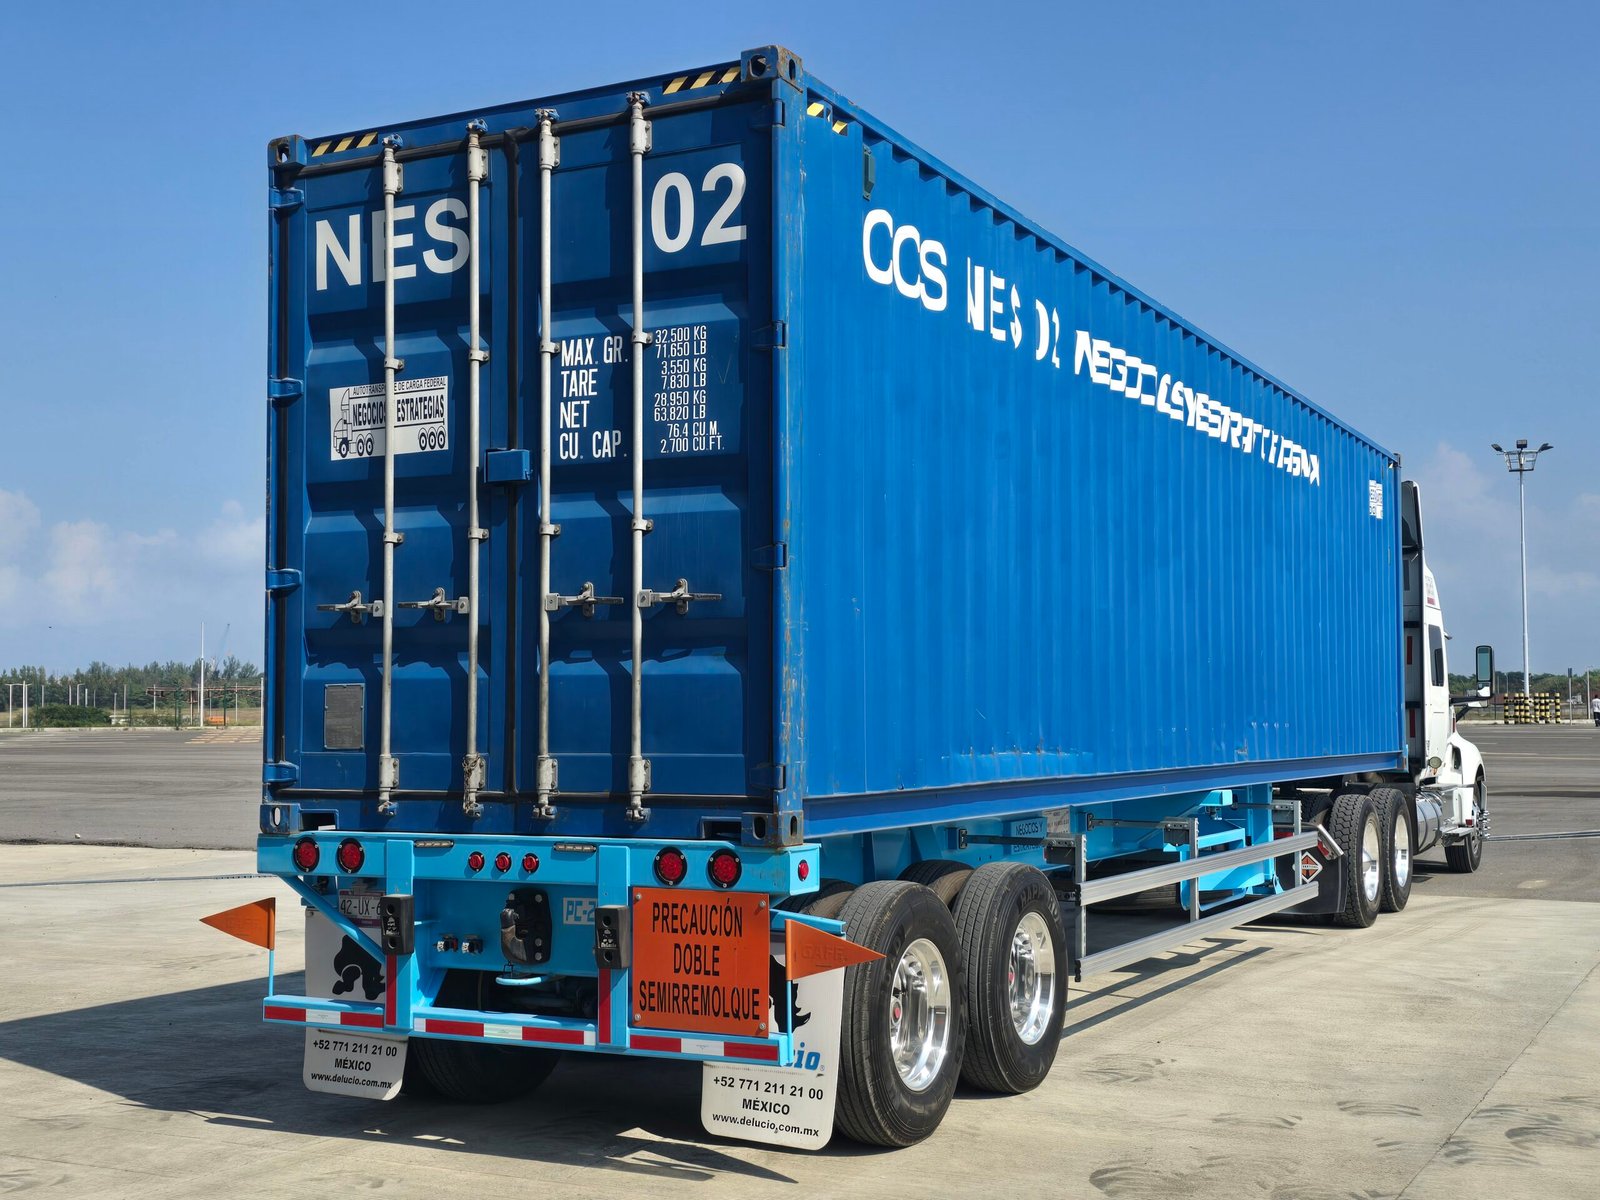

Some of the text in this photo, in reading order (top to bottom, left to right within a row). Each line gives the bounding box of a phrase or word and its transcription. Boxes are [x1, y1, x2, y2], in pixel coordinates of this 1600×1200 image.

[316, 163, 747, 291] NES 02
[863, 209, 947, 311] CCS
[693, 325, 707, 341] KG
[561, 335, 628, 366] MAX. GR.
[693, 341, 707, 356] LB
[661, 357, 707, 375] 3,550 KG
[353, 377, 446, 396] AUTOTRANSPE DE CARGA FEDERAL
[561, 368, 598, 397] TARE
[693, 372, 706, 388] LB
[692, 389, 706, 405] KG
[396, 394, 445, 422] ESTRATEGIAS
[559, 400, 590, 429] NET
[692, 404, 706, 420] LB
[667, 422, 688, 438] 76.4
[559, 430, 627, 459] CU. CAP.
[341, 899, 380, 916] 42-UX-6
[652, 898, 742, 938] PRECAUCIÓN
[673, 943, 720, 976] DOBLE
[639, 980, 760, 1021] SEMIRREMOLQUE
[313, 1040, 397, 1057] +52 771 211 21 00
[334, 1057, 371, 1072] MÉXICO
[311, 1072, 392, 1089] www.delucio.com.mx
[713, 1076, 824, 1100] +52 771 211 21 00
[742, 1097, 790, 1115] MÉXICO
[712, 1113, 820, 1137] www.delucio.com.mx
